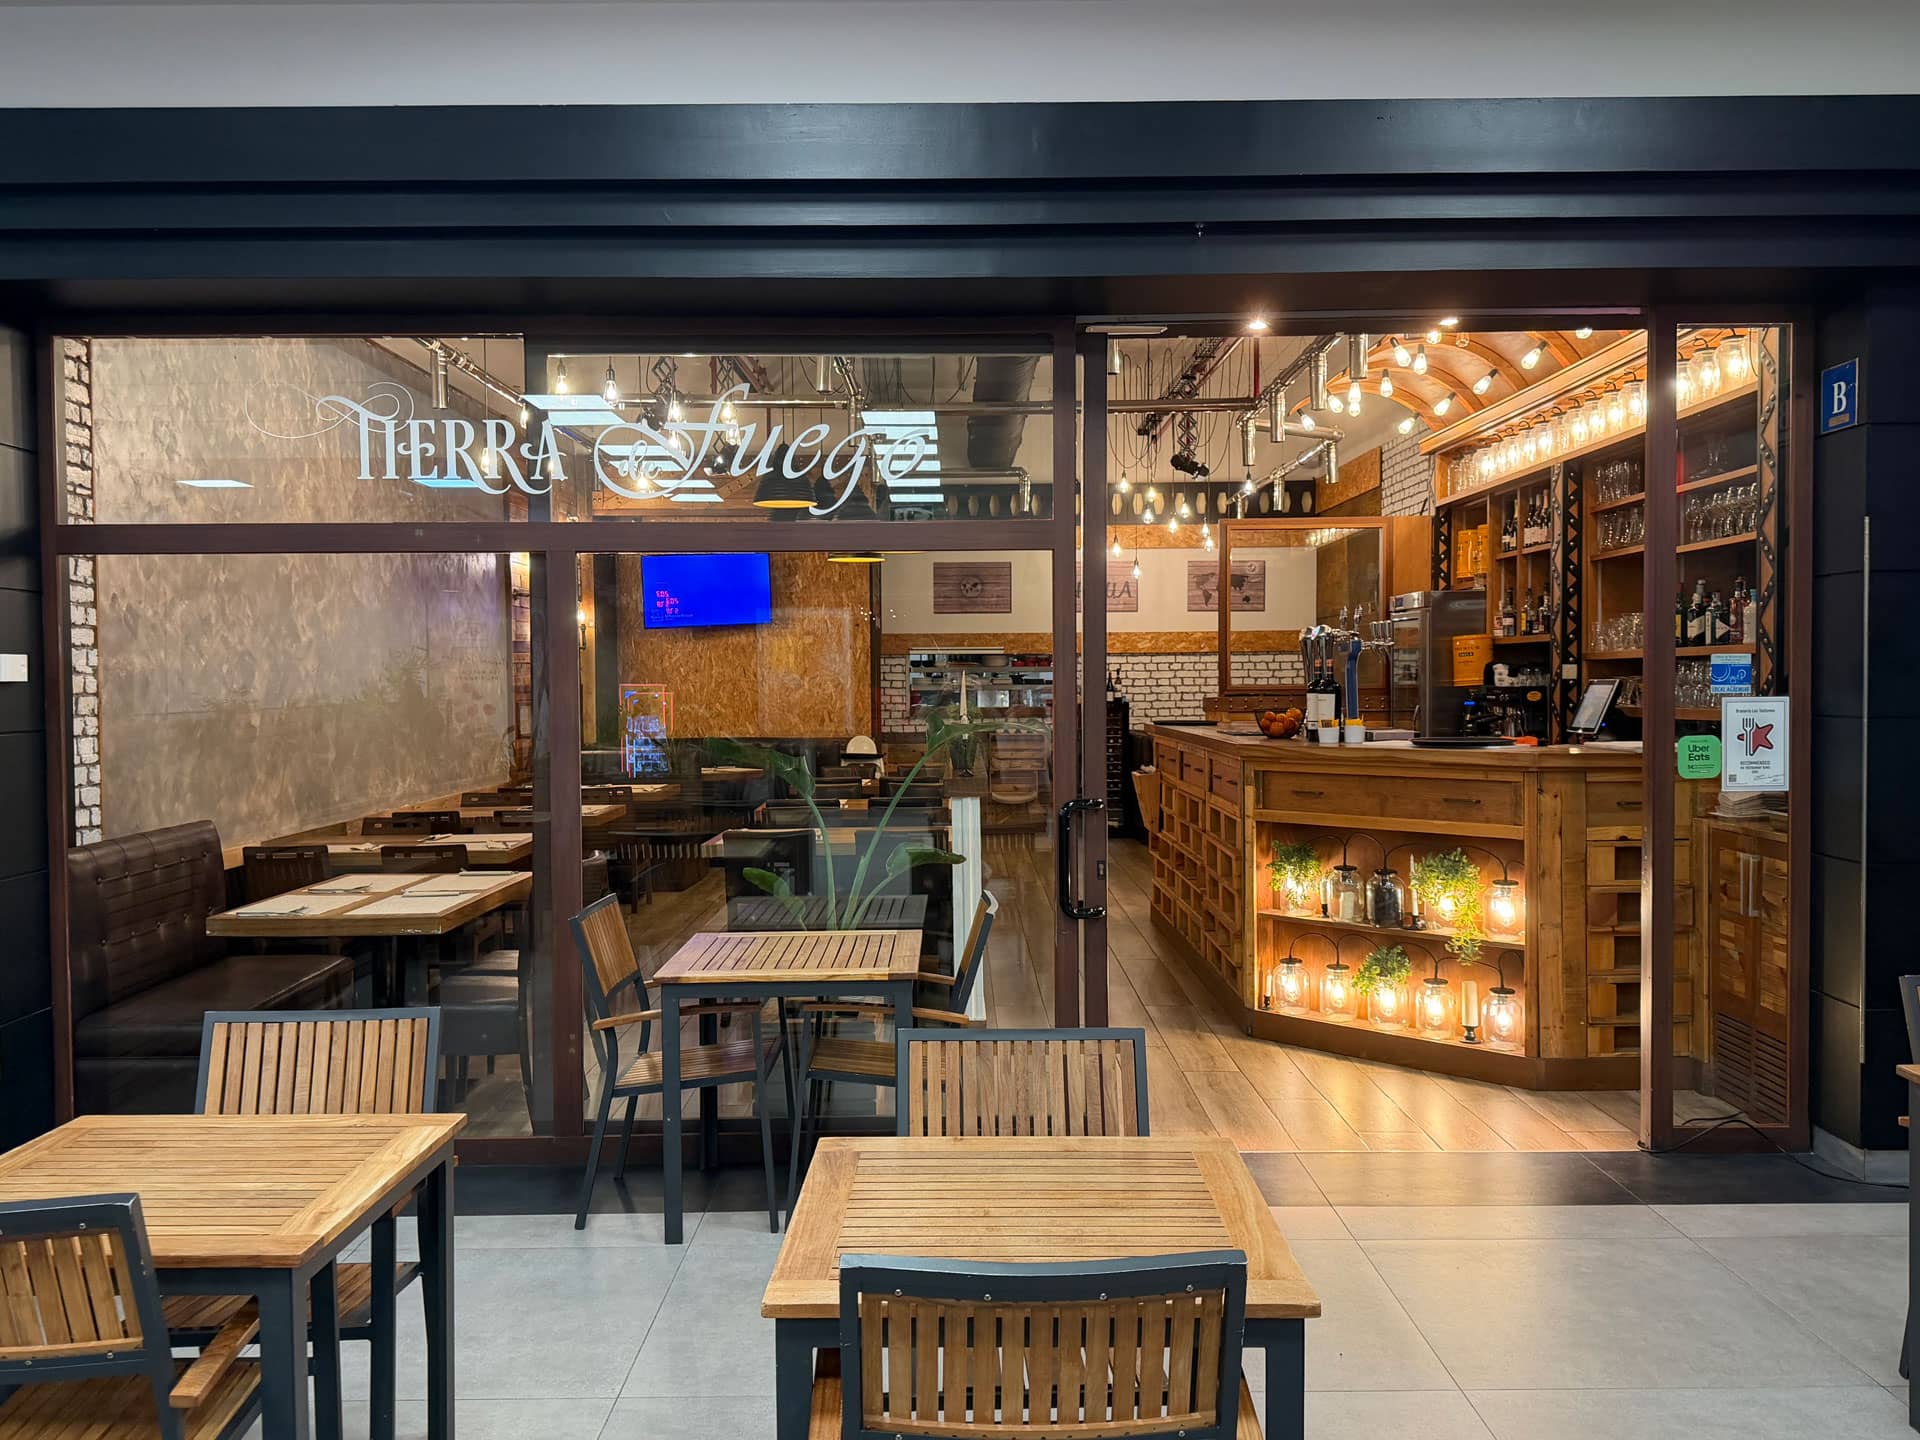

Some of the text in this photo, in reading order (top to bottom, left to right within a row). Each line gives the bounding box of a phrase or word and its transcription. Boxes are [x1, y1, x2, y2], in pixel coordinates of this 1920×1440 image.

[1832, 381, 1847, 414] B
[314, 383, 568, 495] TIERRA
[618, 440, 662, 481] de
[1687, 744, 1710, 753] Uber
[1688, 753, 1710, 761] Eats
